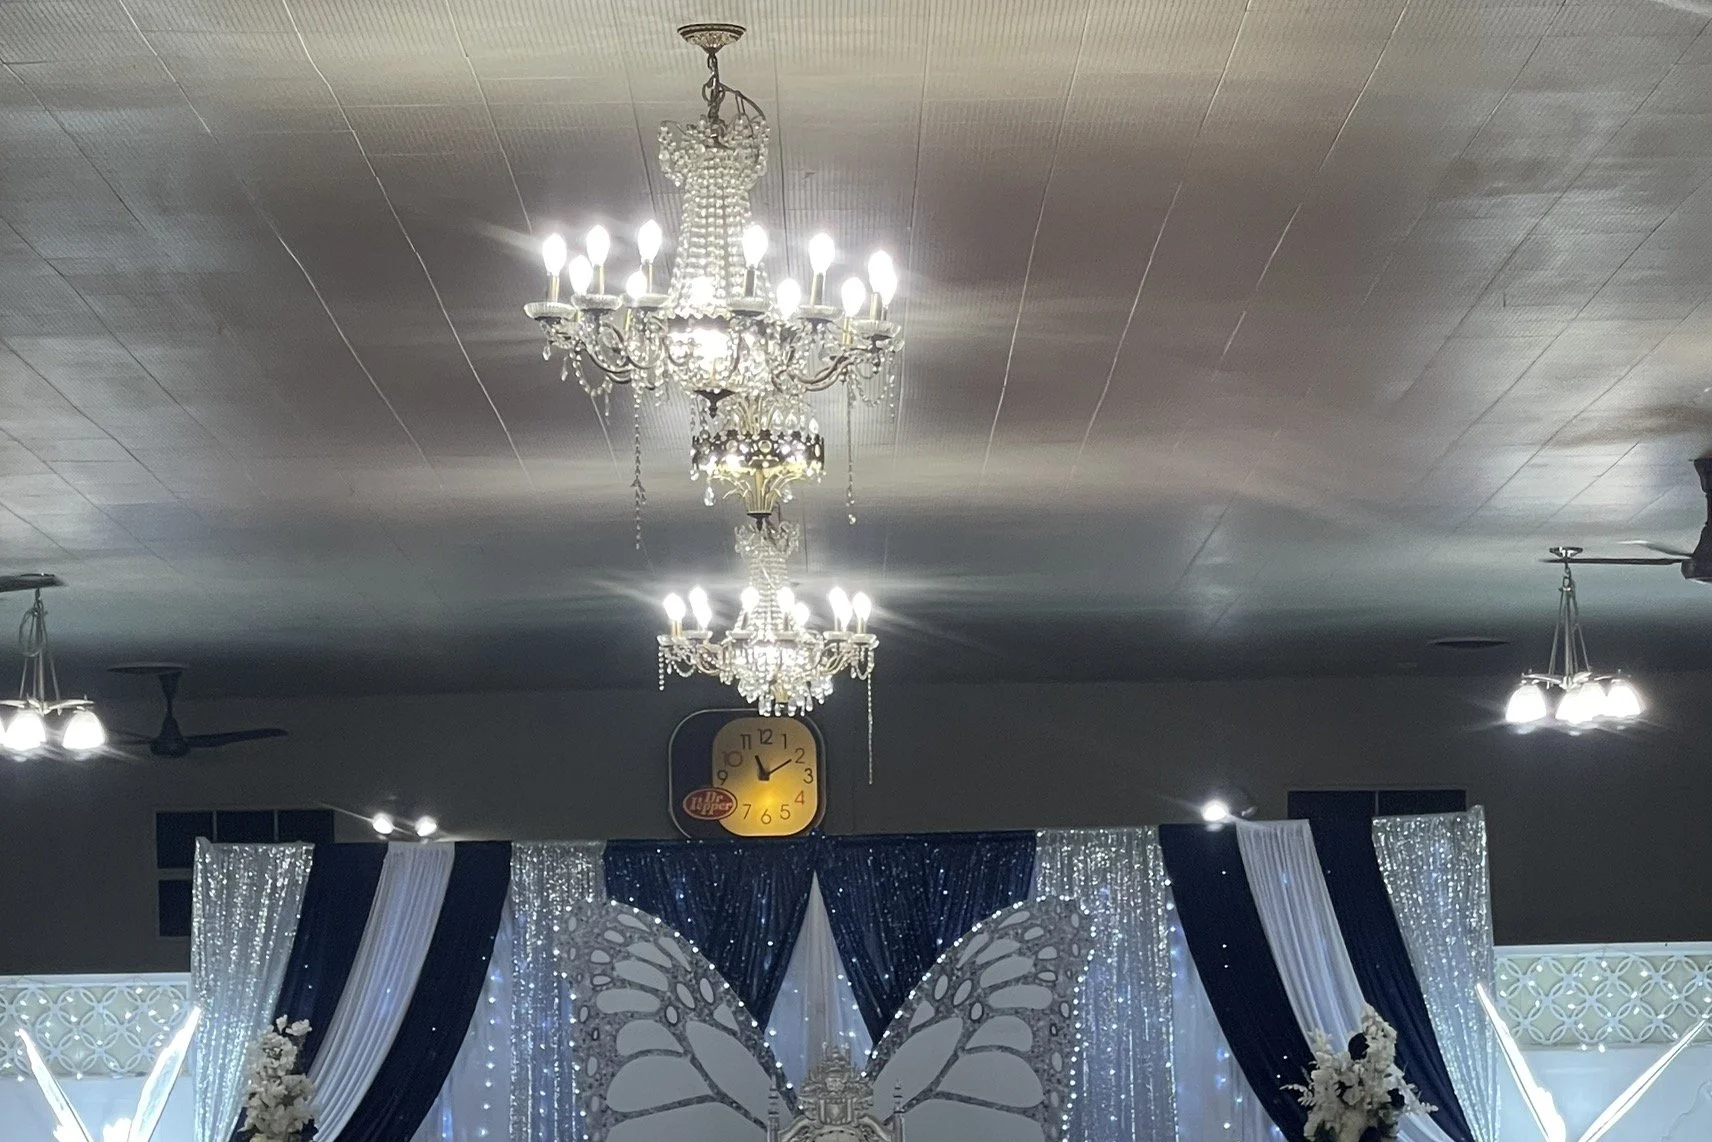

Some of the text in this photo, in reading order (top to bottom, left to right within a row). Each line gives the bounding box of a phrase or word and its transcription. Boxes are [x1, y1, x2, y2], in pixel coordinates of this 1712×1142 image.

[740, 734, 752, 749] 11
[758, 729, 773, 745] 12
[782, 734, 787, 749] 1
[723, 751, 743, 767] 10
[795, 748, 805, 764] 2
[717, 770, 728, 785] 9
[803, 768, 814, 784] 3
[794, 790, 805, 805] 4
[742, 804, 752, 819] 7
[761, 809, 772, 825] 6
[780, 804, 791, 820] 5
